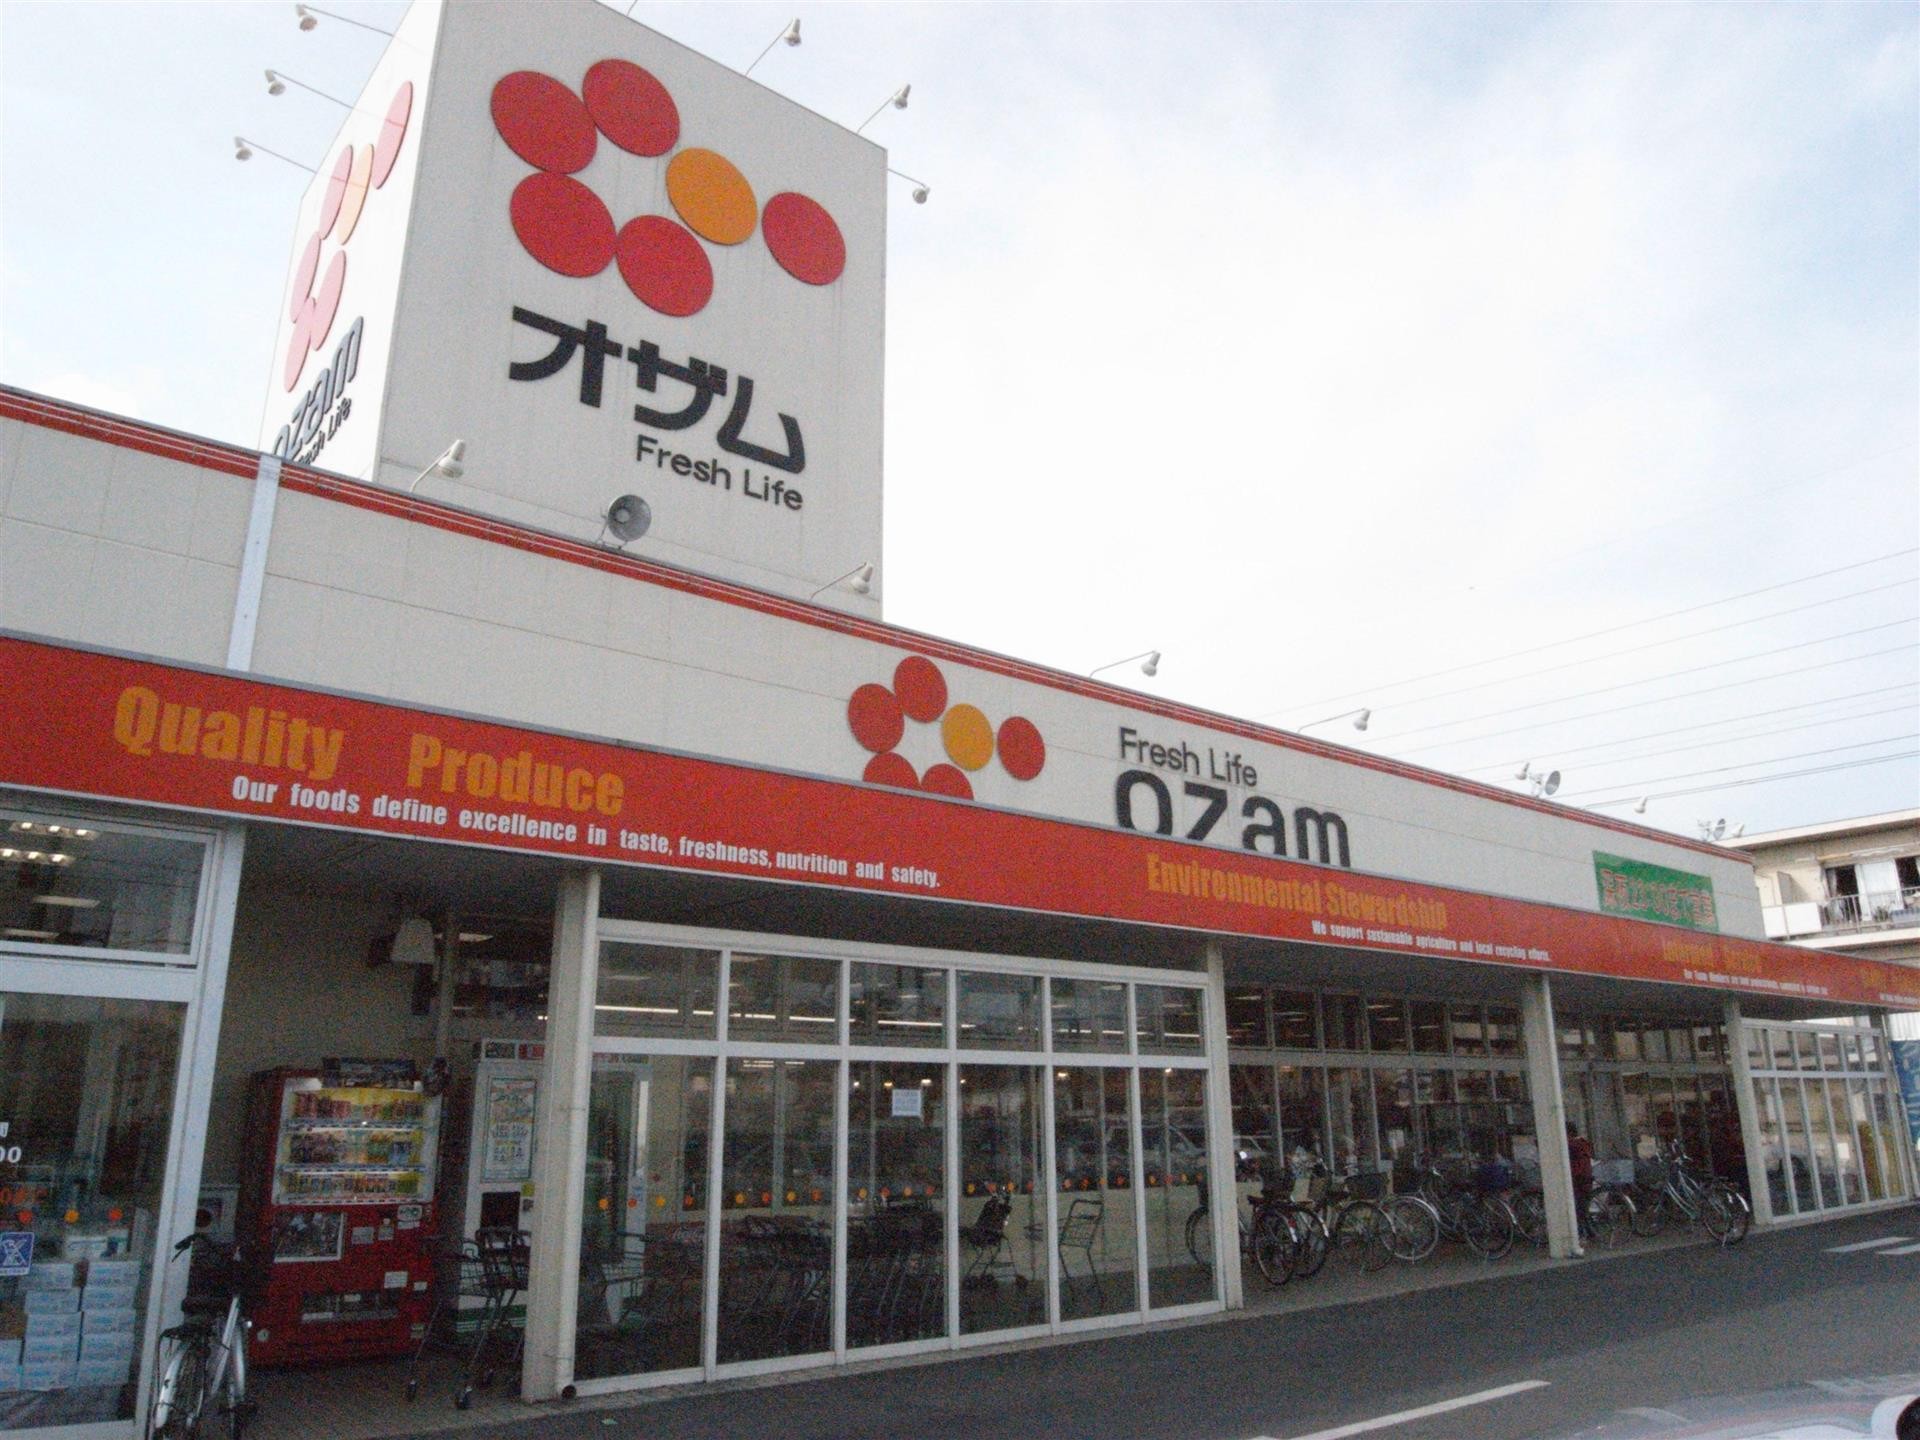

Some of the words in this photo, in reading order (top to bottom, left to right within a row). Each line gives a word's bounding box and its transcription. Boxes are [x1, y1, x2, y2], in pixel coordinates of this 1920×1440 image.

[508, 305, 806, 475] オザム
[635, 433, 732, 490] Fresh
[743, 468, 804, 511] Life
[112, 685, 346, 782] Quality
[406, 732, 626, 818] Produce
[1119, 726, 1201, 776] Fresh
[1209, 747, 1258, 788] Life
[232, 774, 278, 805] Our
[290, 782, 361, 816] foods
[371, 793, 448, 827] define
[458, 805, 578, 845] excellence
[587, 822, 607, 847] in
[619, 827, 673, 857] taste,
[678, 835, 772, 869] freshness,
[775, 849, 848, 877] nutrition
[855, 860, 885, 882] and
[891, 865, 941, 889] safety.
[1147, 852, 1323, 914] Environmental
[1326, 880, 1448, 931] Stewardship
[1311, 919, 1327, 936] We
[1330, 924, 1364, 940] support
